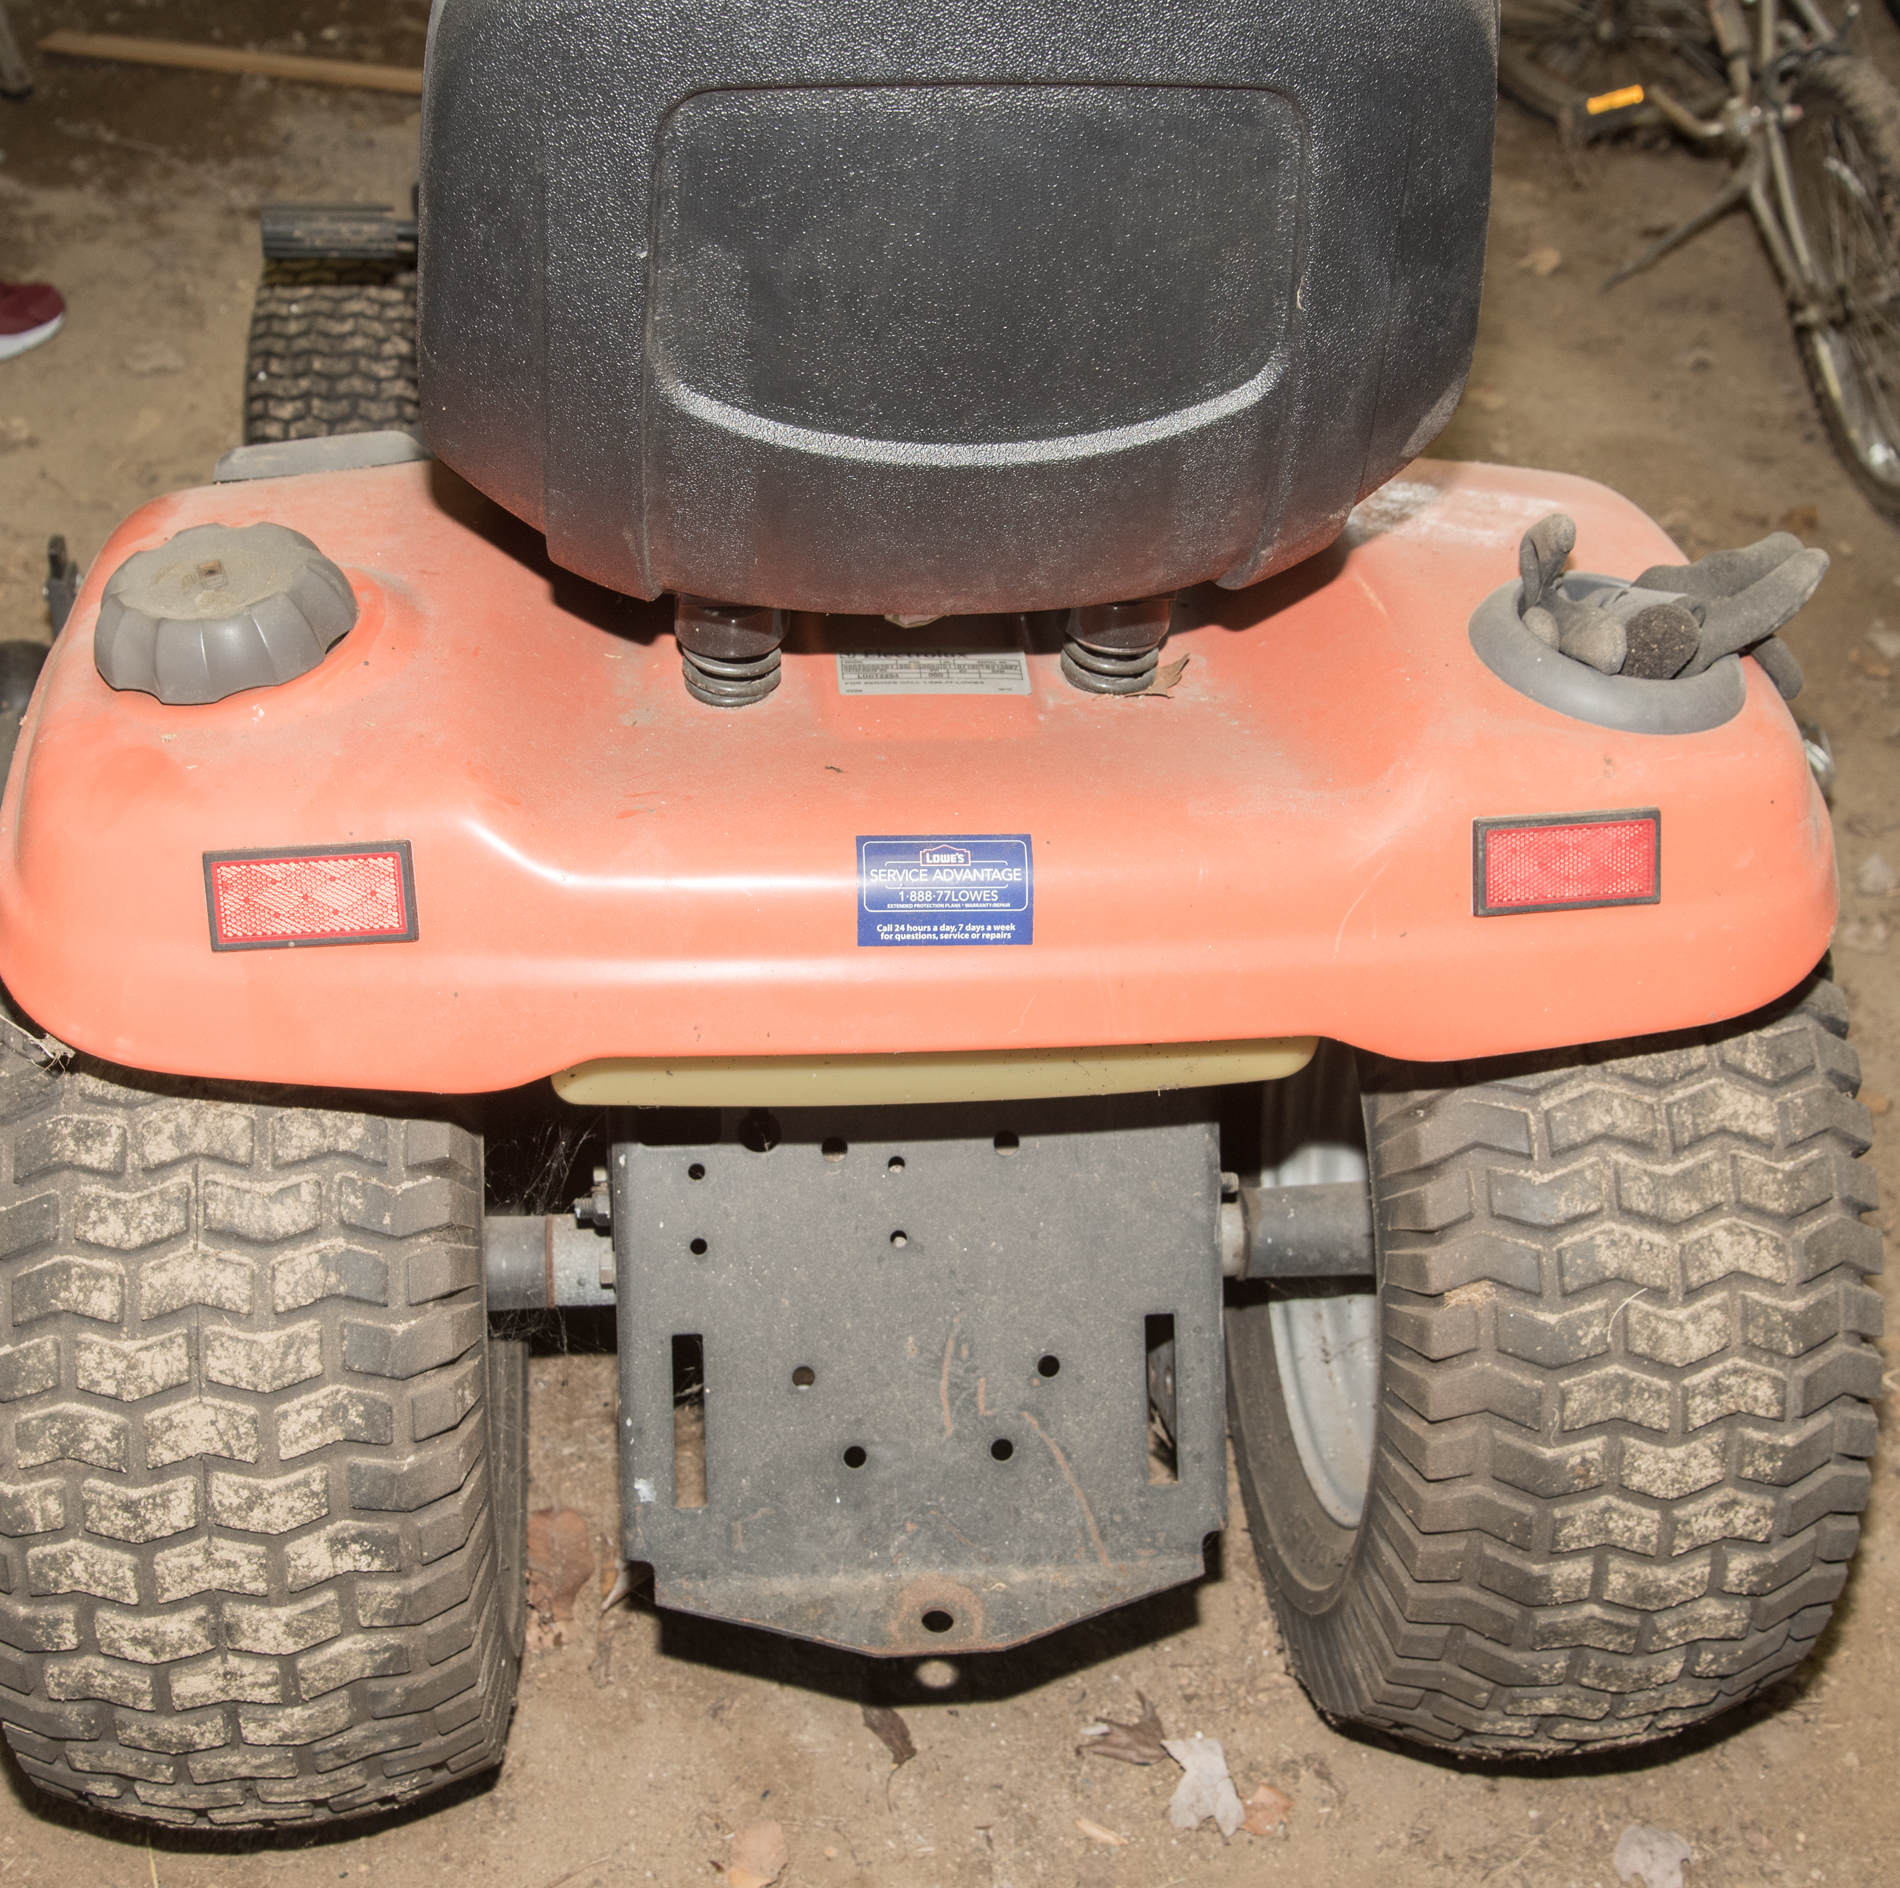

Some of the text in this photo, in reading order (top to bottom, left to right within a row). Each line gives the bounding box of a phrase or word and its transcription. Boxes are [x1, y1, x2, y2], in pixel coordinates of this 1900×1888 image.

[926, 852, 965, 863] LOWE'S
[870, 868, 1022, 882] SERVICE ADVANTAGE
[876, 924, 893, 932] Call
[940, 923, 957, 933] day,
[958, 923, 964, 931] 7
[965, 923, 985, 932] days
[993, 923, 1016, 931] week
[880, 932, 893, 940] for
[894, 932, 939, 941] questions,
[981, 931, 1012, 940] repairs
